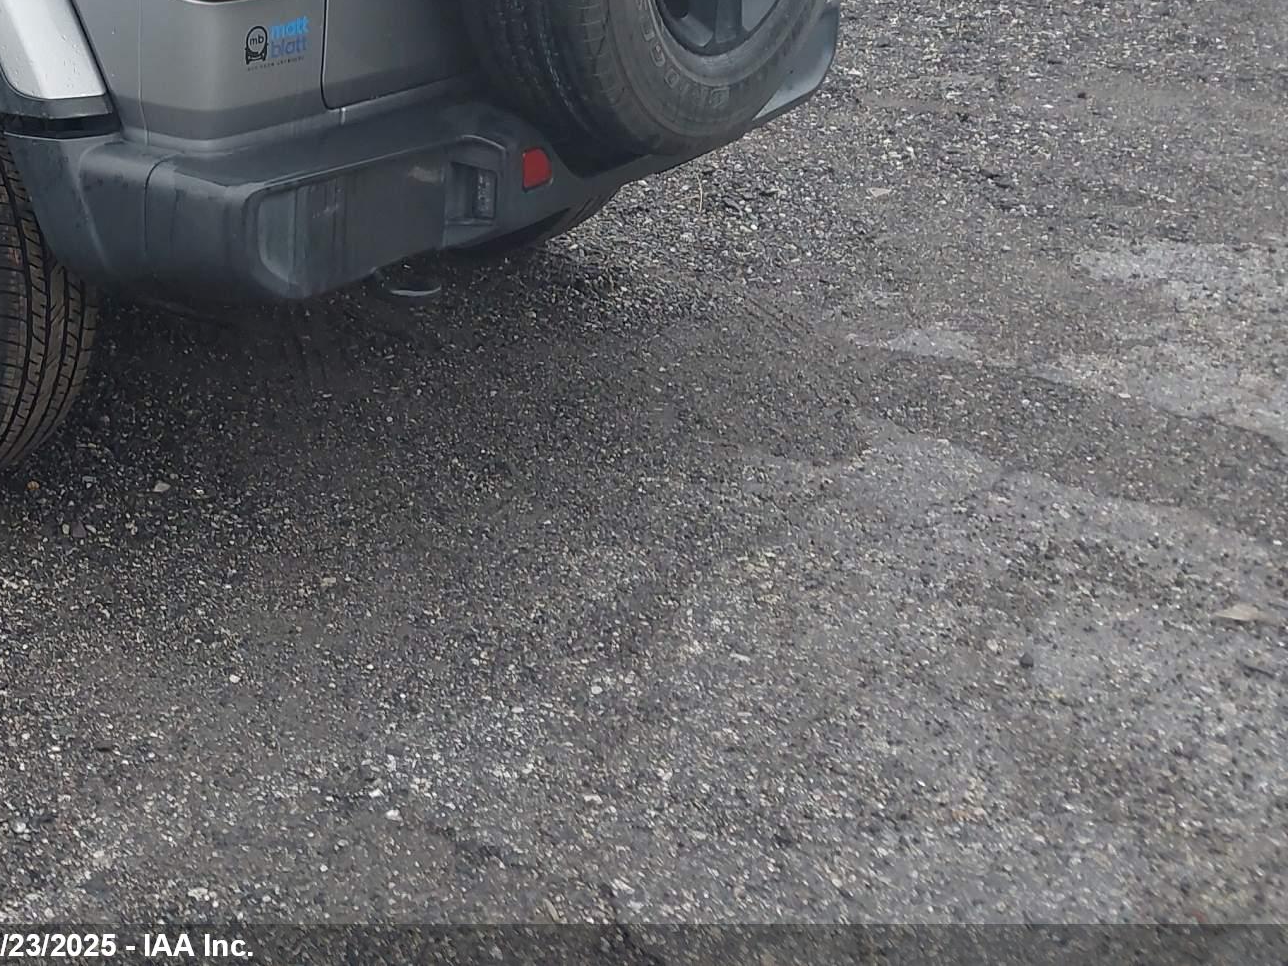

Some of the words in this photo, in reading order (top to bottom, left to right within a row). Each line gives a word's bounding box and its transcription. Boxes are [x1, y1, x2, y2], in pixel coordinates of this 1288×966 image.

[270, 16, 310, 39] matt
[249, 34, 265, 46] mb
[270, 37, 308, 59] blatt
